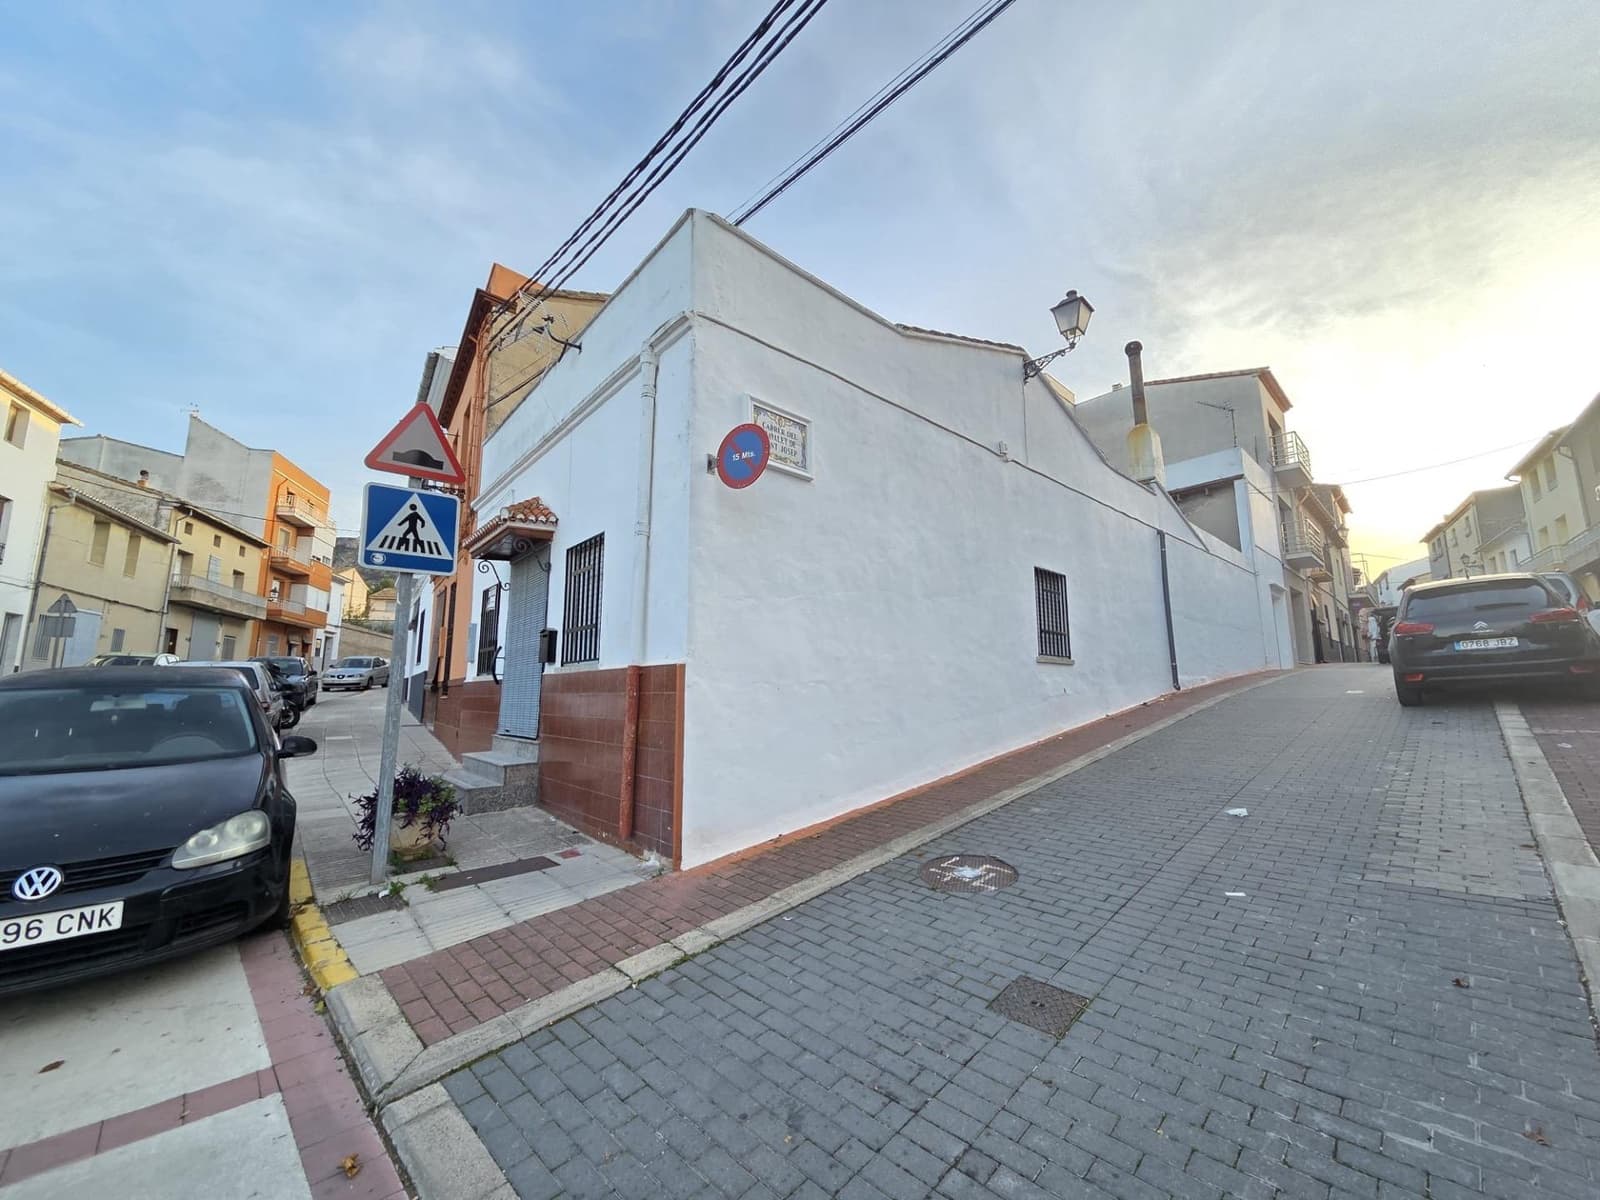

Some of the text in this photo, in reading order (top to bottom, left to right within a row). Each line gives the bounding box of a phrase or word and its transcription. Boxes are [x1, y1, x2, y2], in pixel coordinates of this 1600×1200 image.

[786, 431, 798, 441] DEL
[781, 445, 797, 457] JOSEP
[732, 453, 740, 461] 15
[1461, 639, 1489, 649] 0768
[2, 906, 116, 944] 96 CNK
